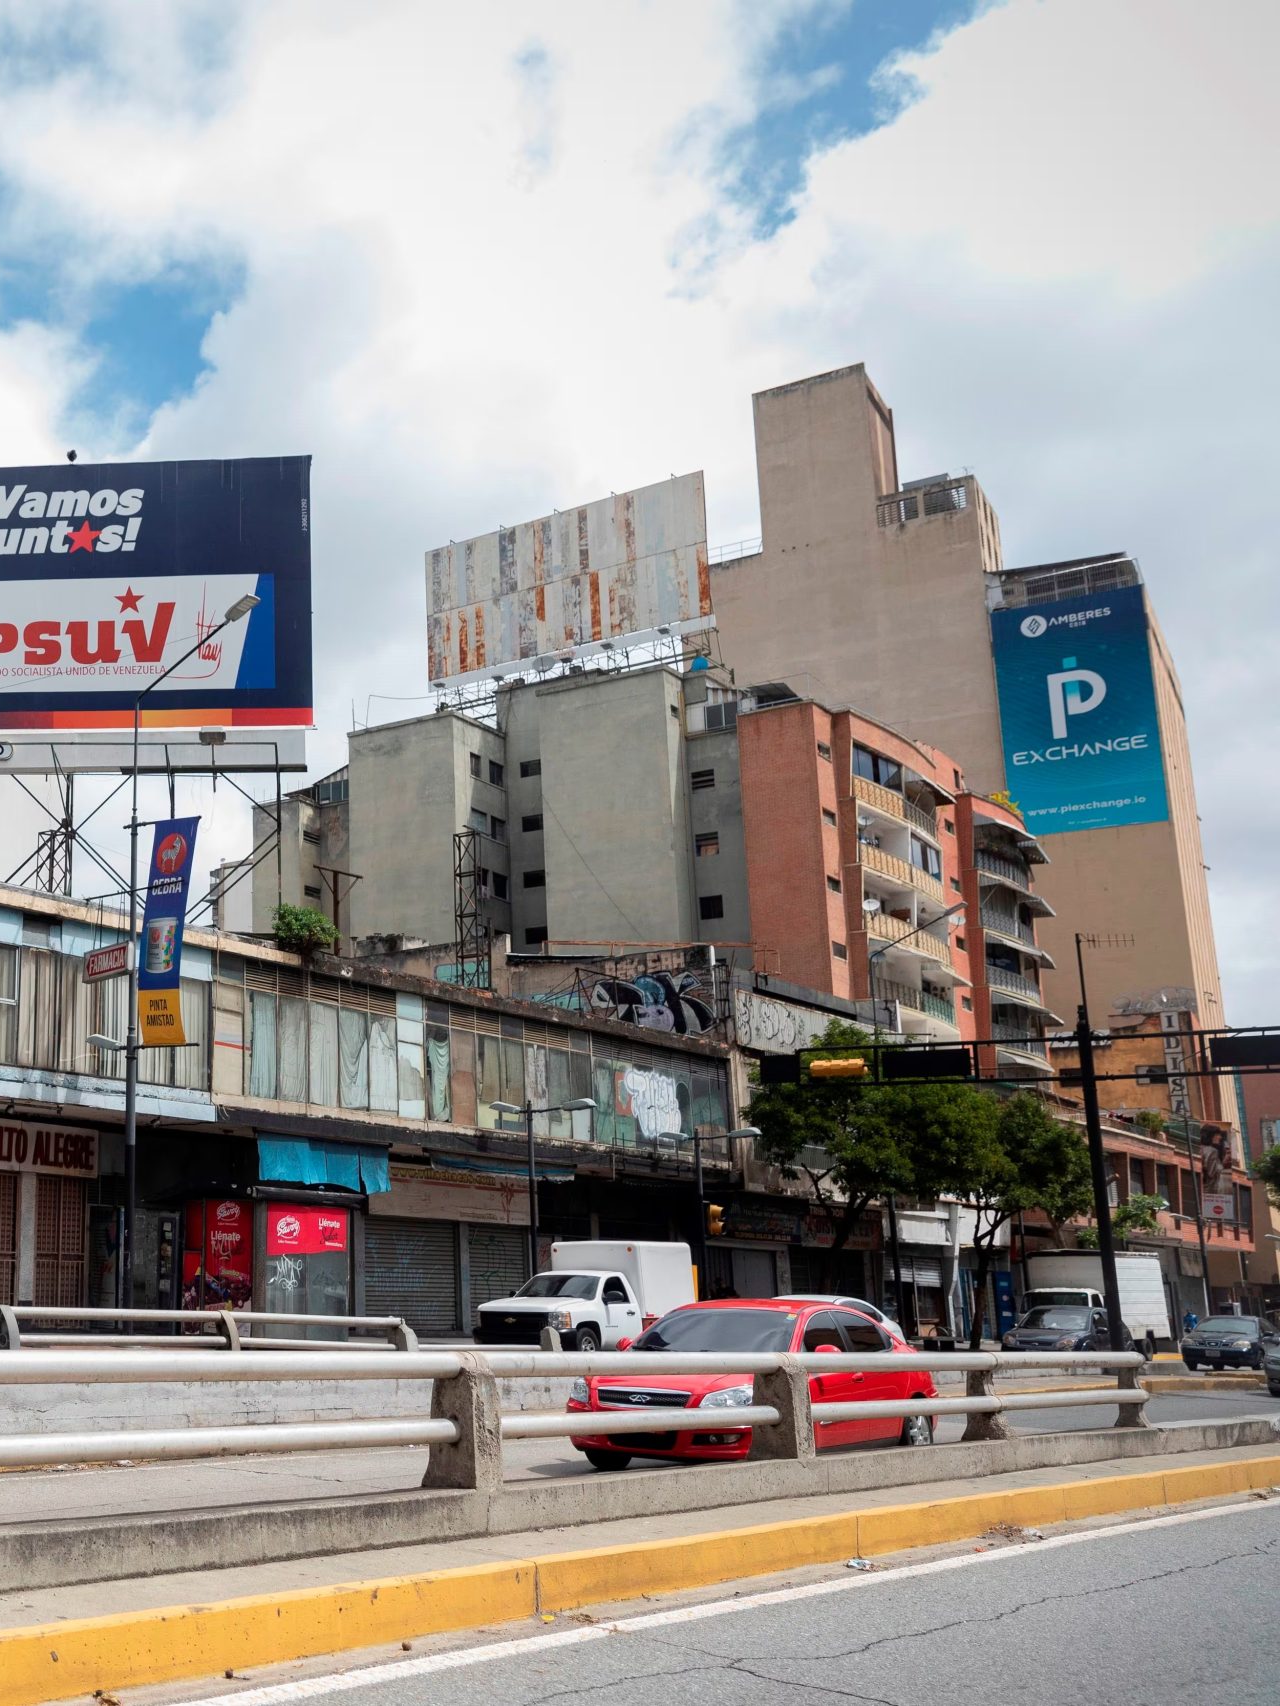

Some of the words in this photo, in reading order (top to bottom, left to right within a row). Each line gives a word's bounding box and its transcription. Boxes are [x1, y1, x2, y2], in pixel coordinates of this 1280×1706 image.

[1047, 607, 1111, 628] AMBERES
[11, 667, 63, 677] SOCIALISTA
[65, 666, 96, 676] UNIDO
[98, 666, 111, 675] DE
[112, 665, 167, 675] VENEZUELA
[1012, 734, 1148, 766] EXCHANGE
[1027, 795, 1146, 816] www.piexchange.io
[152, 877, 184, 896] CEBRA
[88, 945, 126, 976] FARMACIA
[149, 998, 168, 1012] PINTA
[146, 1013, 175, 1027] AMISTAD
[32, 1130, 95, 1171] ALEGRE
[277, 1216, 300, 1237] Savoy
[318, 1217, 341, 1229] Llénate
[210, 1231, 241, 1242] Llénate
